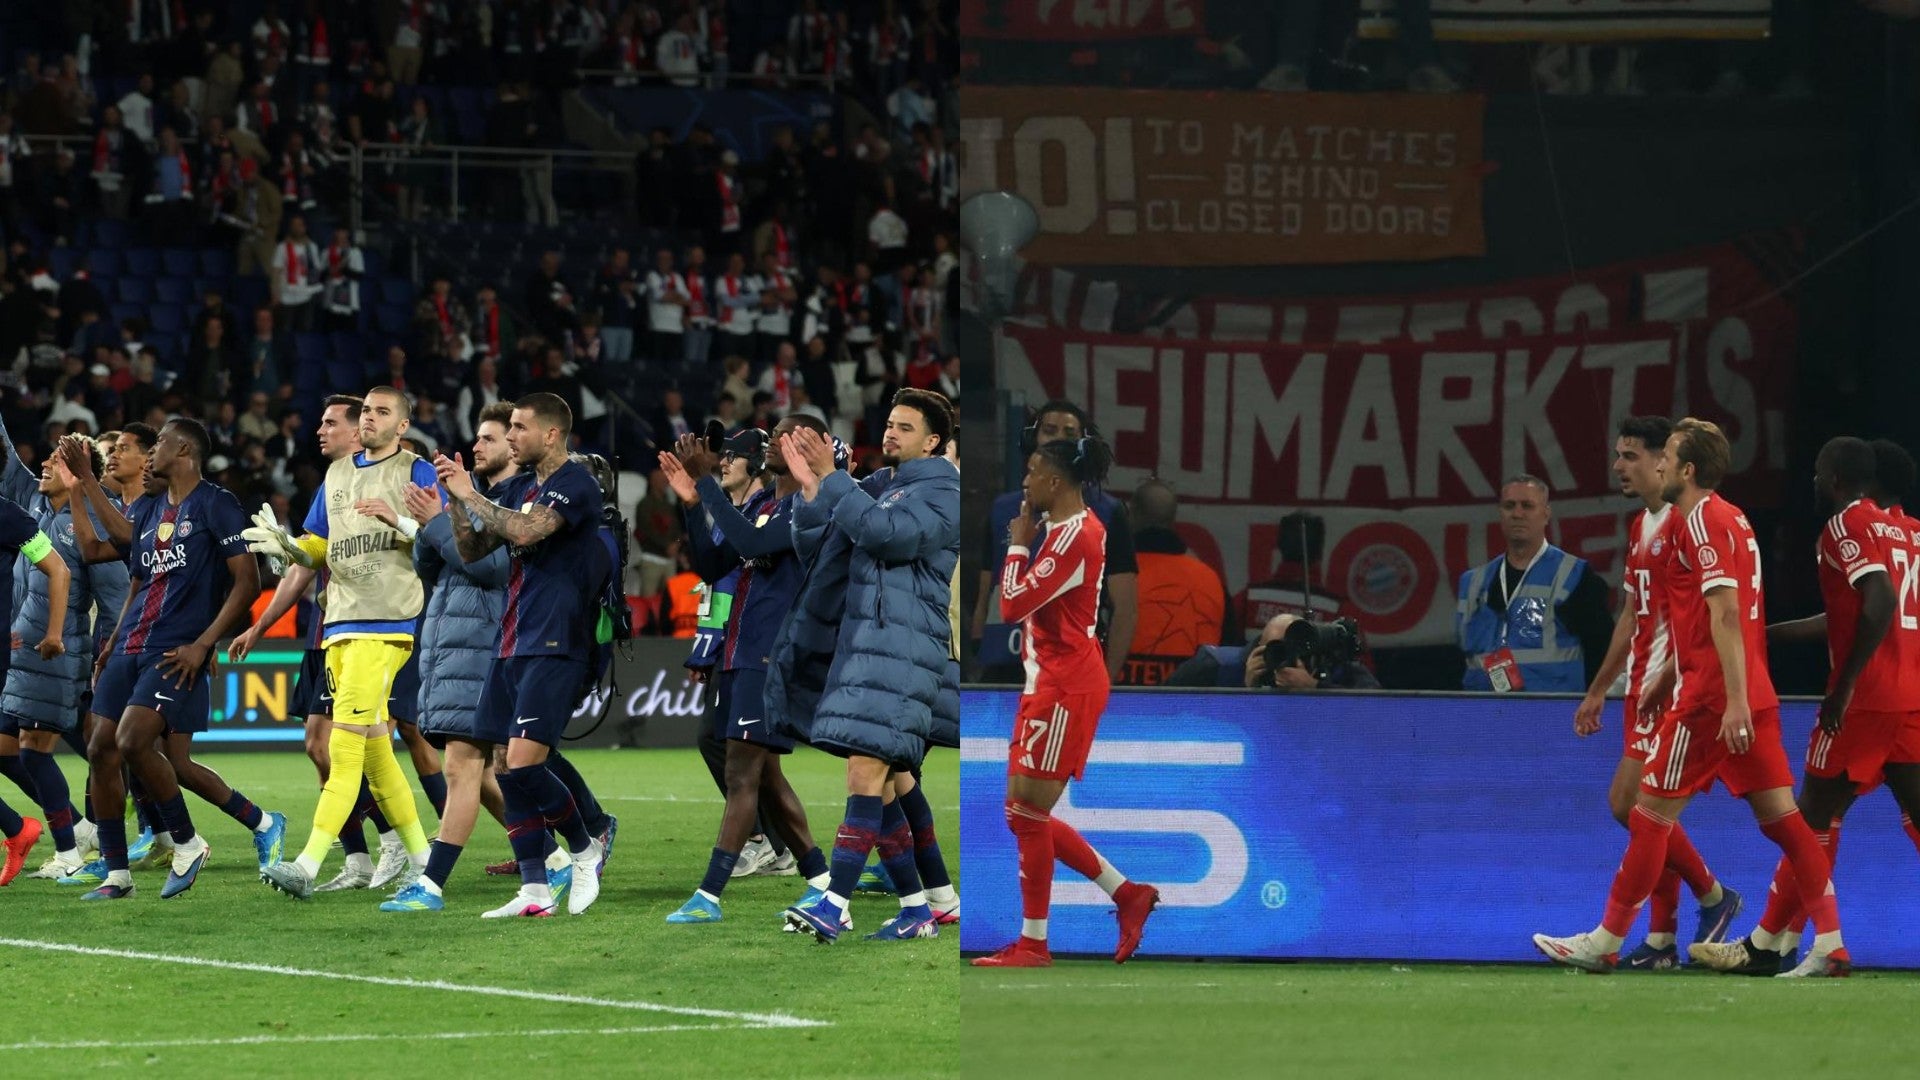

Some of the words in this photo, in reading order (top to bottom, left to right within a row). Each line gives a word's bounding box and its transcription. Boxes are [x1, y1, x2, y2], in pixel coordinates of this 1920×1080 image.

[1145, 117, 1203, 156] TO
[1231, 122, 1457, 167] MATCHES
[1223, 162, 1380, 200] BEHIND
[1146, 200, 1302, 235] CLOSED
[1325, 203, 1454, 237] DOORS
[995, 336, 1672, 501] NEUMARKT
[141, 544, 186, 567] QATAR
[330, 530, 399, 563] #FOOTBALL
[150, 558, 187, 575] AIRWAYS
[351, 562, 382, 577] RESPECT
[626, 669, 706, 717] chil
